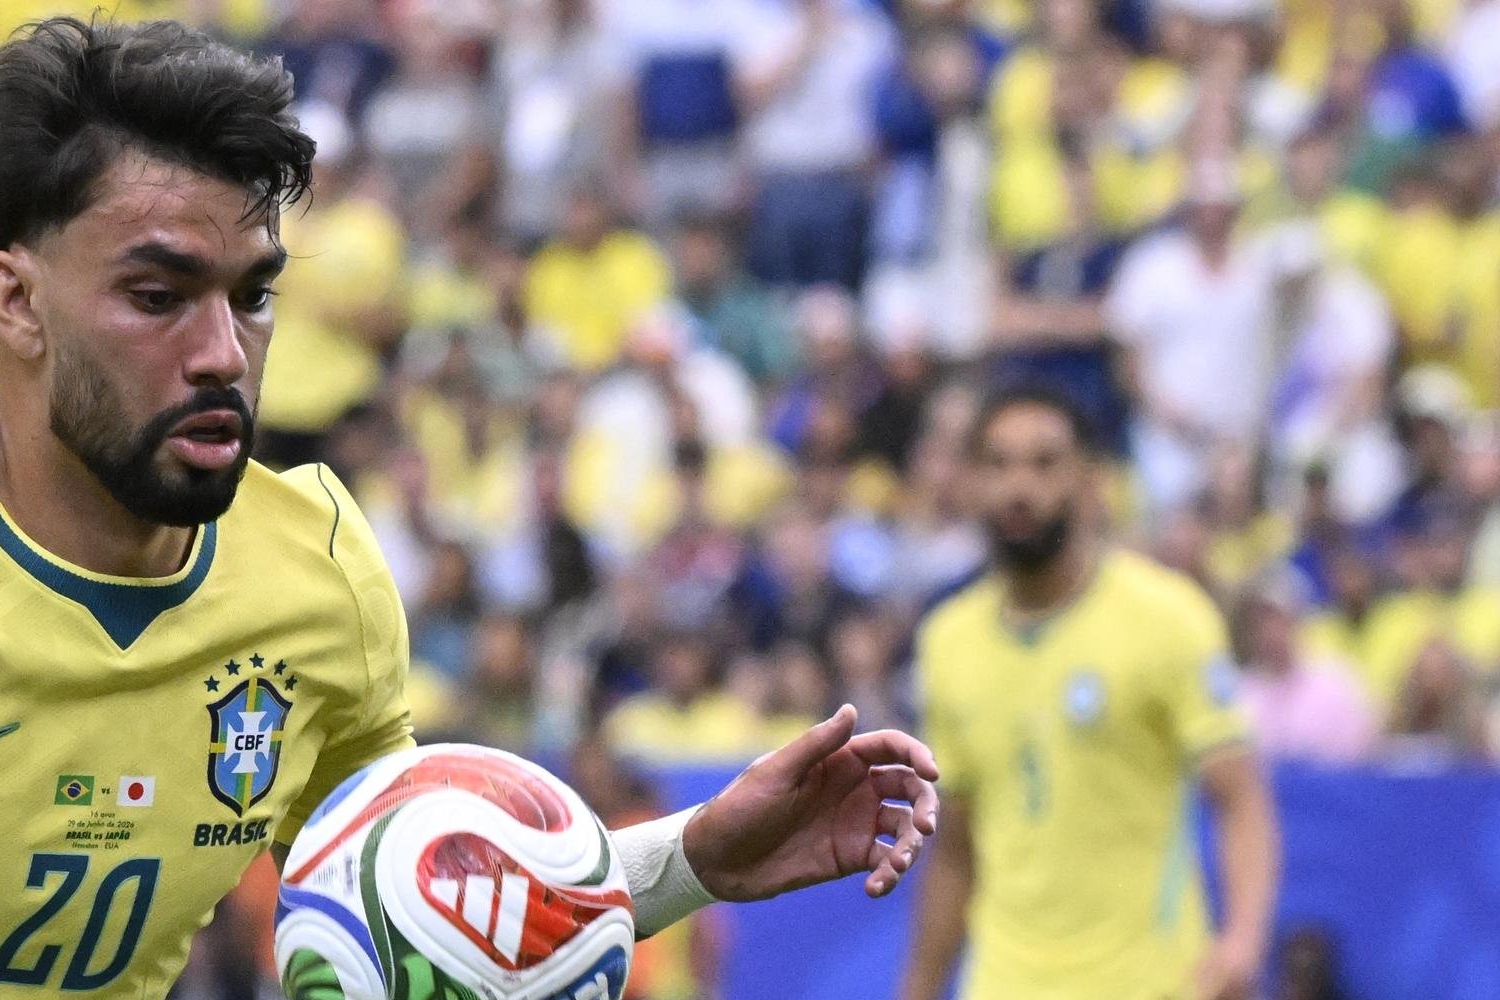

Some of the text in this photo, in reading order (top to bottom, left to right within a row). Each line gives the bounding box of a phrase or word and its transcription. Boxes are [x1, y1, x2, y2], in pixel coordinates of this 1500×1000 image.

[234, 734, 265, 751] CBF
[67, 819, 76, 828] 29
[77, 820, 86, 828] de
[66, 831, 92, 840] BRASIL
[105, 830, 131, 840] JAPÃO
[193, 819, 270, 847] BRASIL
